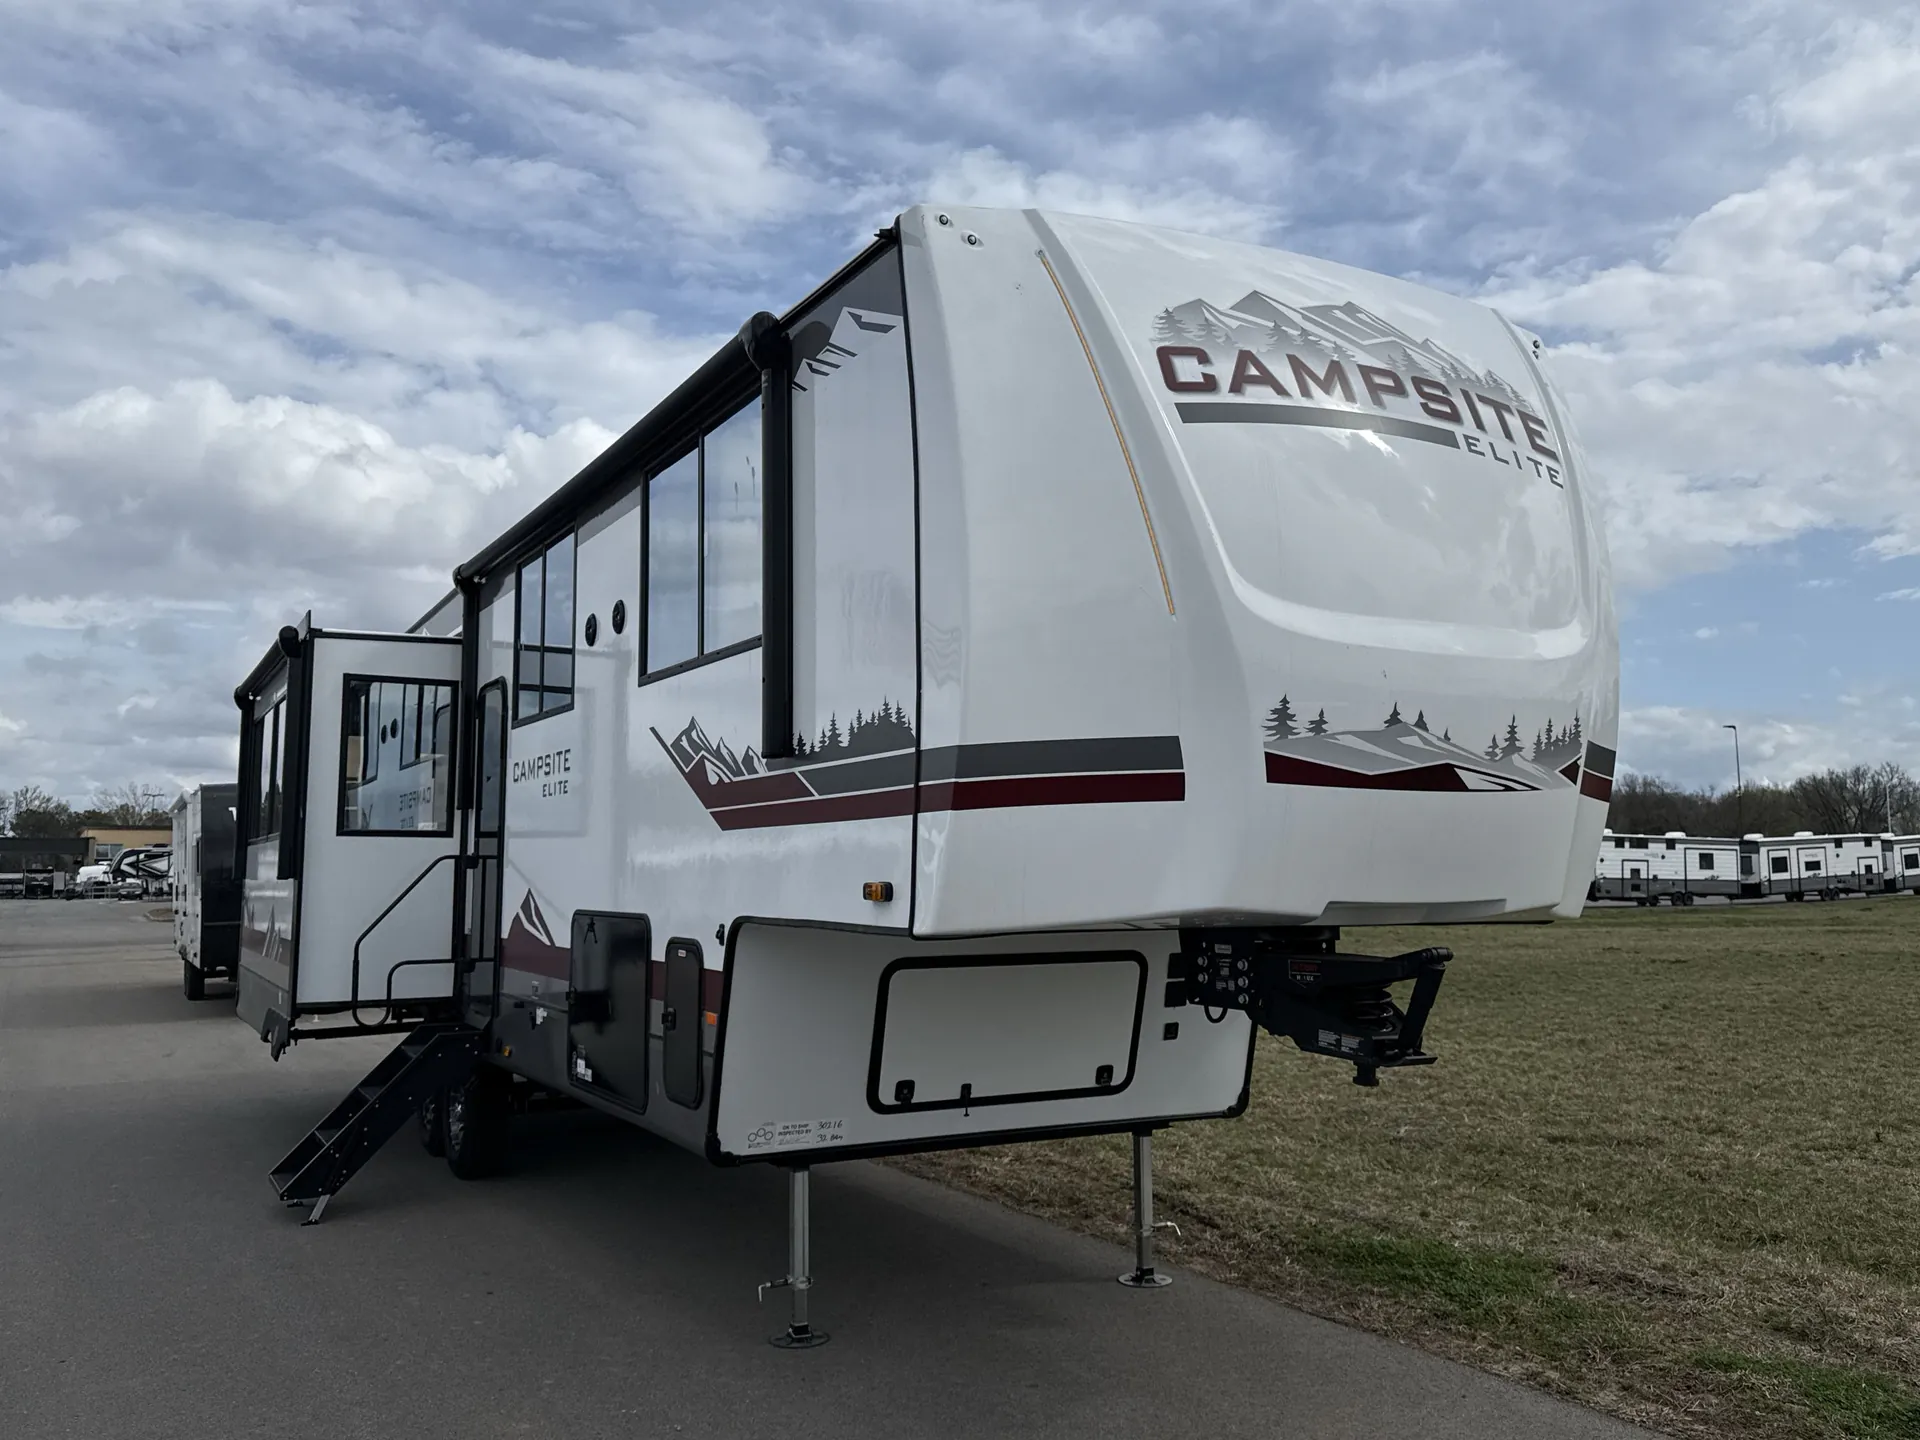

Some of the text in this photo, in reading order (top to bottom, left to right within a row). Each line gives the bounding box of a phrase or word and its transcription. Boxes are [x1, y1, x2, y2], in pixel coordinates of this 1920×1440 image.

[1156, 346, 1561, 463] CAMPSITE
[1462, 433, 1564, 490] ELITE
[513, 748, 571, 783] CAMPSITE
[542, 780, 569, 798] ELITE
[777, 1129, 804, 1137] INSPECTED
